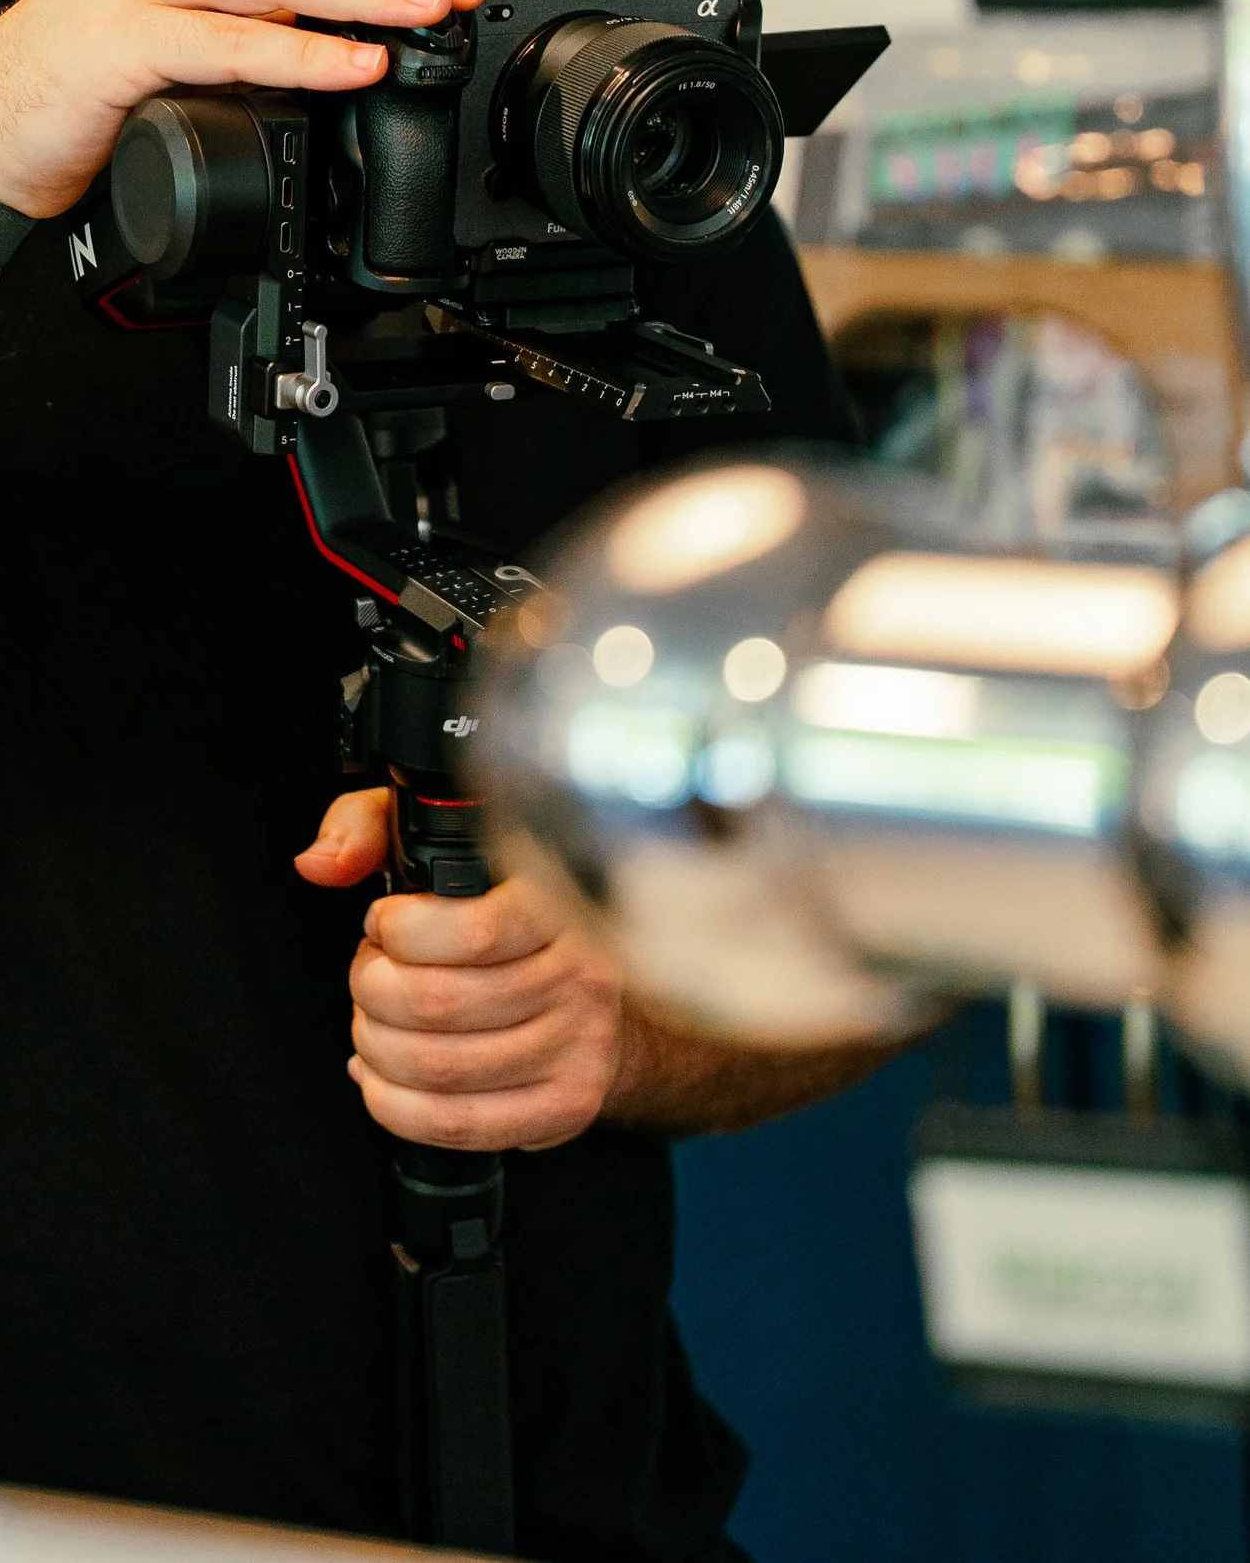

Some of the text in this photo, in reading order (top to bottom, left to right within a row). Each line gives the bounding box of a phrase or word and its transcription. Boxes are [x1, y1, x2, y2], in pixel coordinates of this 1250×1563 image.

[678, 81, 716, 91] FE 1.8/50
[727, 165, 760, 215] 0.45m/1.48ft
[495, 247, 527, 255] WOODEN
[496, 252, 525, 261] CAMERA
[285, 336, 291, 345] 2
[514, 354, 623, 407] 6 5 4 3 2 1 0
[681, 389, 722, 399] M4 M4
[281, 436, 288, 444] 5
